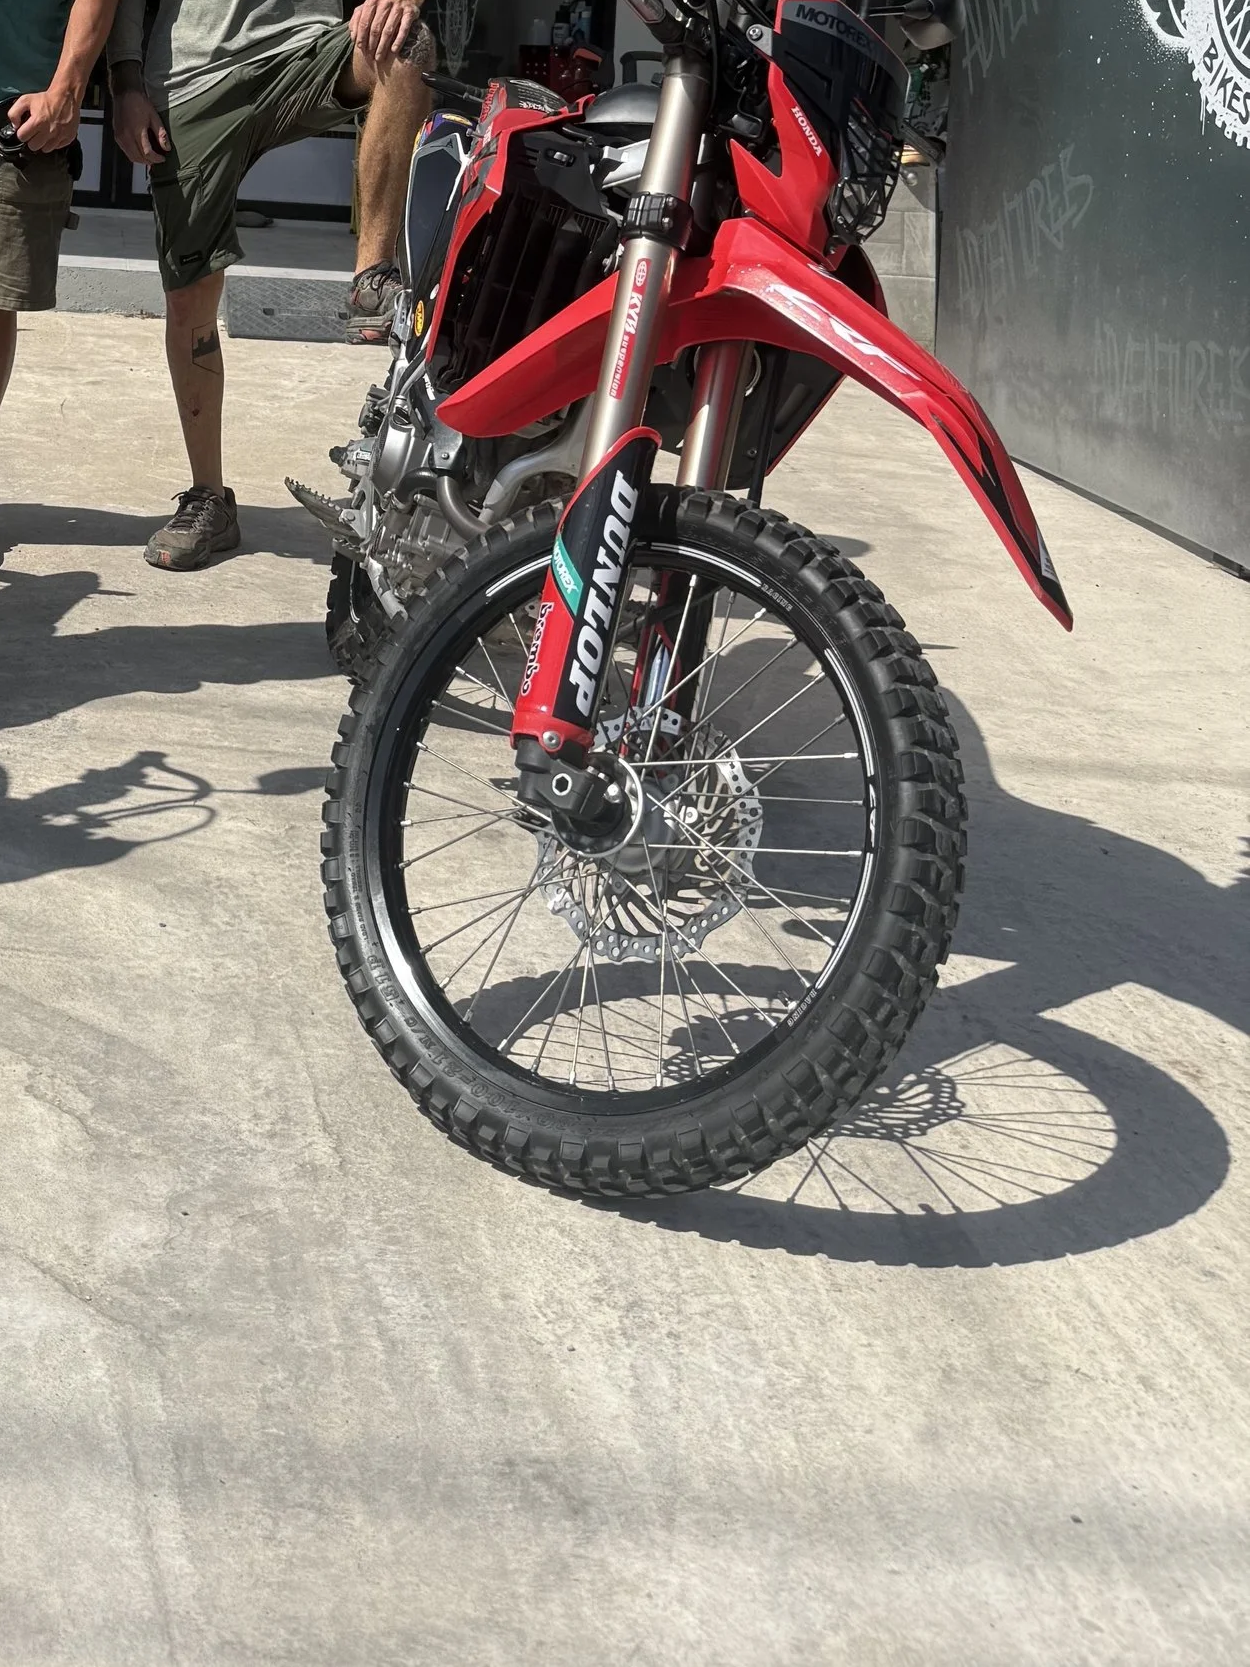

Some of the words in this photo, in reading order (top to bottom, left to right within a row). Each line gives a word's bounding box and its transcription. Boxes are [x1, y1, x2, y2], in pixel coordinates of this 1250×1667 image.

[791, 105, 823, 158] HONDA
[609, 335, 630, 398] suspension
[569, 469, 639, 718] DUNLOP
[521, 602, 555, 696] brembo
